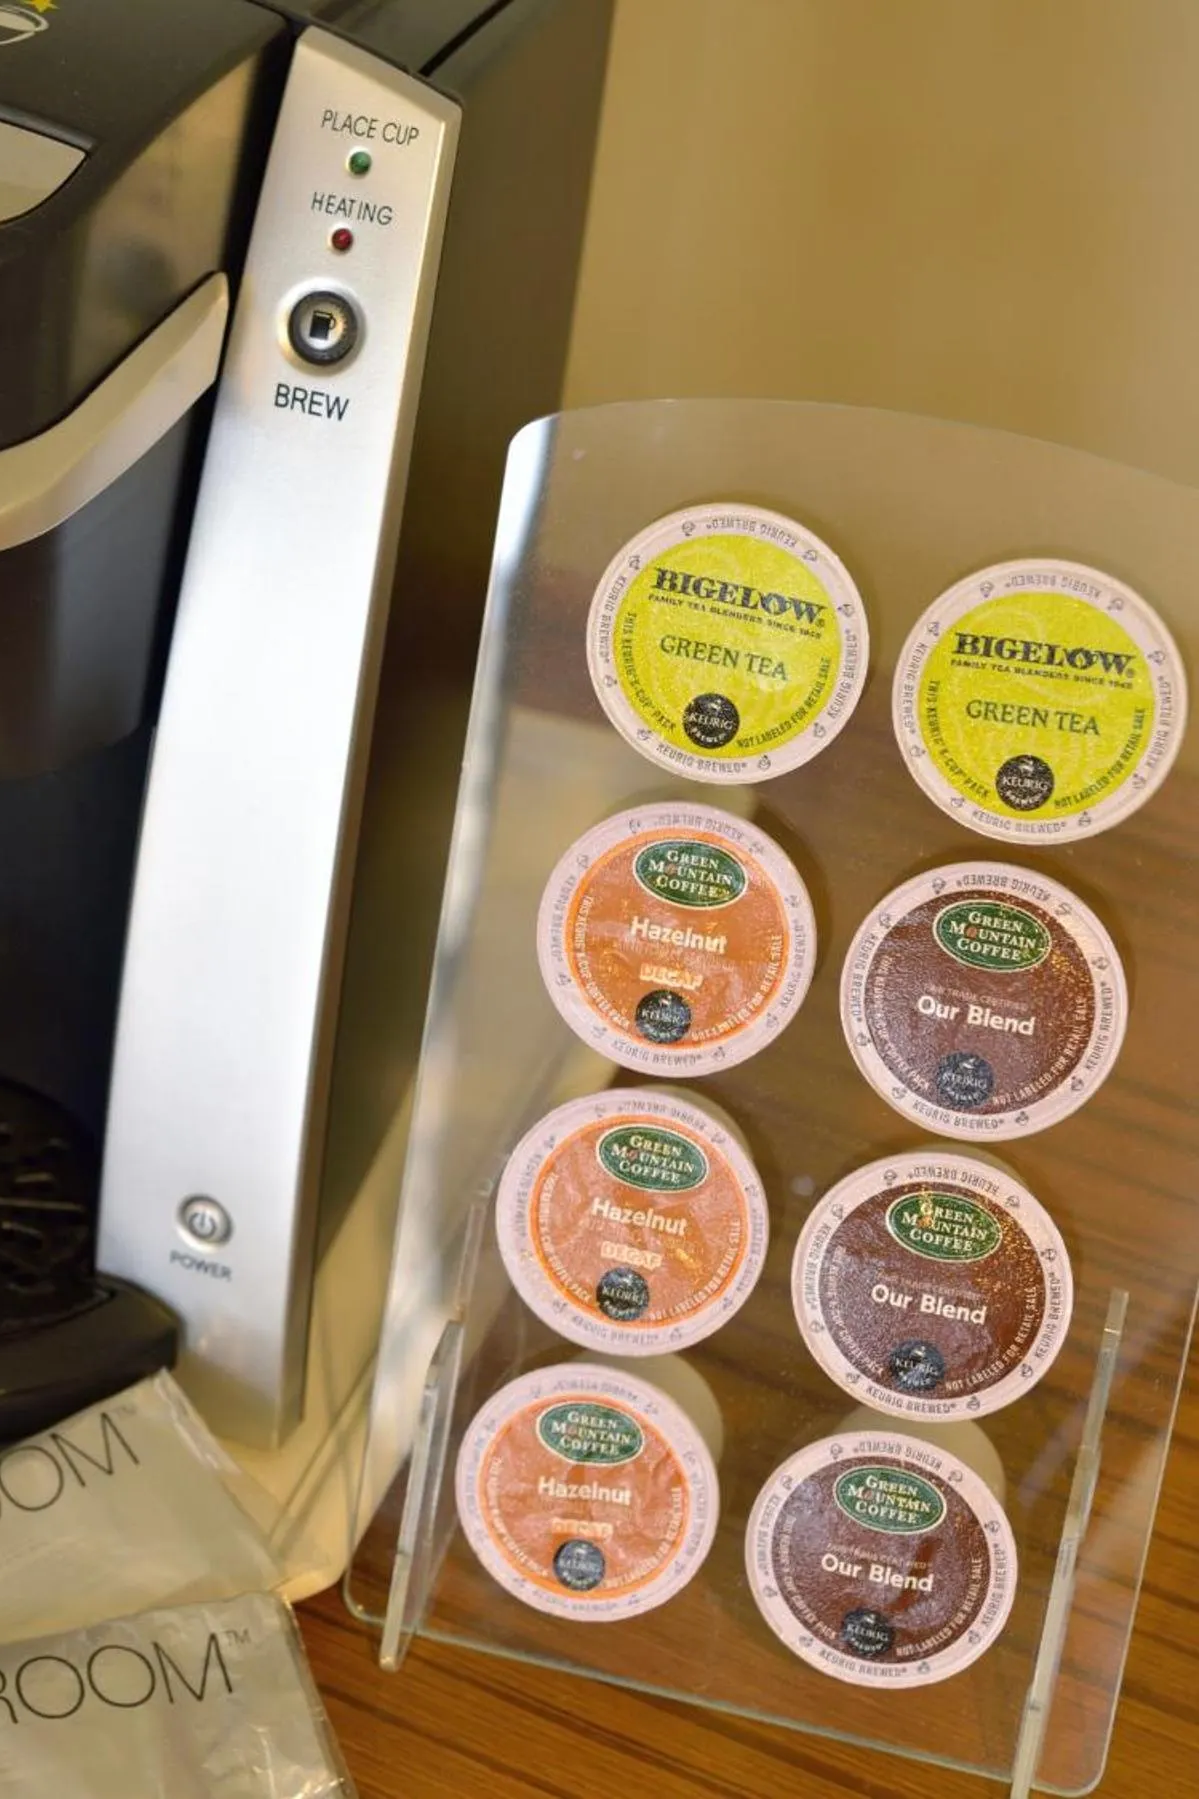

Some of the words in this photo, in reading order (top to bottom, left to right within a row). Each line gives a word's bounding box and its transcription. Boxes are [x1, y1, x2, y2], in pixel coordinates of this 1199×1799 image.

[320, 108, 377, 139] PLACE
[382, 121, 420, 147] CUP
[311, 191, 394, 226] HEATING
[274, 383, 350, 421] BREW
[648, 594, 683, 608] FAMILY
[660, 634, 740, 669] GREEN
[745, 652, 789, 681] TEA
[950, 659, 987, 670] FAMILY
[991, 664, 1011, 674] TEA
[1074, 675, 1104, 686] SINCE
[966, 699, 1049, 728] GREEN
[1054, 711, 1100, 736] TEA
[648, 859, 733, 885] MOUNTAIN
[666, 850, 719, 869] GREEN
[630, 915, 728, 954] Hazelnut
[949, 920, 1037, 949] MOUNTAIN
[968, 911, 1023, 933] GREEN
[956, 938, 1022, 961] COFFEE
[918, 995, 960, 1021] Our
[967, 1004, 1036, 1036] Blend
[611, 1143, 695, 1173] MOUNTAIN
[630, 1135, 682, 1157] GREEN
[620, 1160, 681, 1184] COFFEE
[591, 1198, 687, 1237] Hazelnut
[902, 1211, 988, 1241] MOUNTAIN
[921, 1202, 974, 1223] GREEN
[910, 1229, 973, 1252] COFFEE
[170, 1249, 232, 1282] POWER
[871, 1284, 913, 1309] Our
[920, 1293, 988, 1325] Blend
[1024, 1286, 1038, 1311] SALE
[1014, 1314, 1035, 1345] RETAIL
[1002, 1344, 1020, 1363] FOR
[945, 1380, 963, 1392] NOT
[966, 1359, 1005, 1387] LABELED
[551, 1420, 632, 1445] MOUNTAIN
[567, 1411, 618, 1430] GREEN
[559, 1435, 620, 1456] COFFEE
[538, 1475, 632, 1506] Hazelnut
[847, 1483, 932, 1512] MOUNTAIN
[865, 1475, 919, 1497] GREEN
[855, 1500, 918, 1524] COFFEE
[821, 1553, 862, 1578] Our
[869, 1563, 934, 1592] Blend
[971, 1557, 982, 1579] SALE
